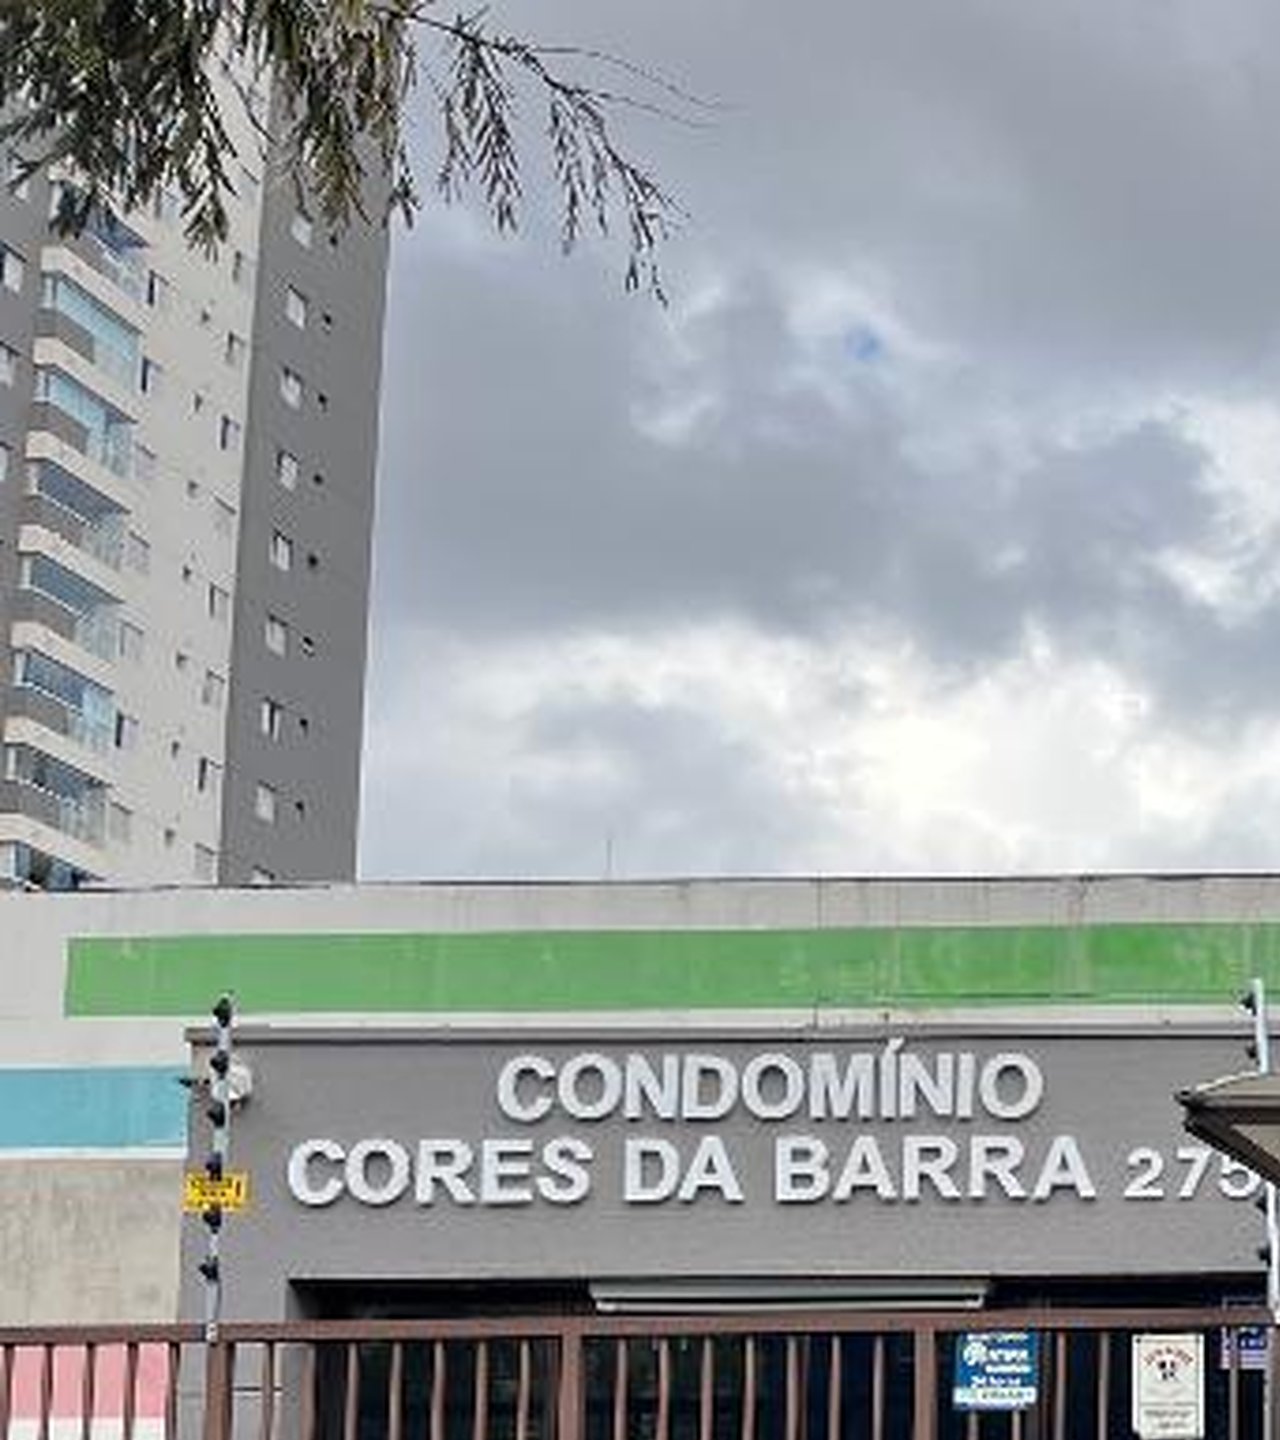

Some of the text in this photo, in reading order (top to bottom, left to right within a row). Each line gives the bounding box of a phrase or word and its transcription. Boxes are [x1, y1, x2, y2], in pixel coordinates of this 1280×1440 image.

[497, 1037, 1045, 1122] CONDOMÍNIO
[287, 1136, 595, 1205] CORES
[623, 1135, 745, 1202] DA
[775, 1135, 1097, 1202] BARRA
[1123, 1146, 1262, 1199] 275
